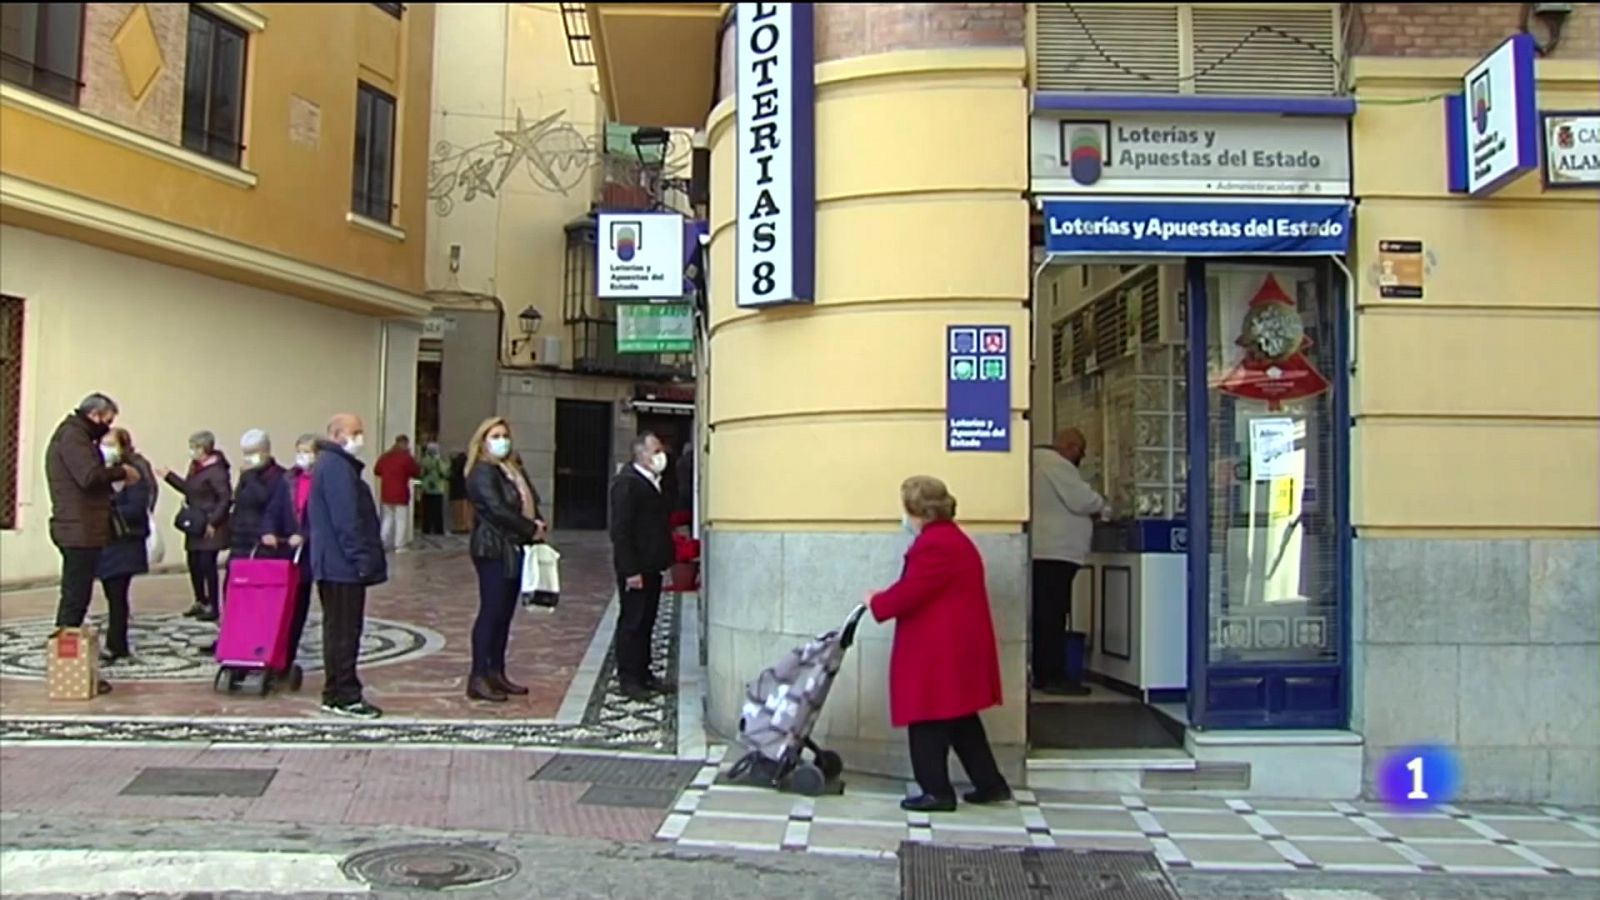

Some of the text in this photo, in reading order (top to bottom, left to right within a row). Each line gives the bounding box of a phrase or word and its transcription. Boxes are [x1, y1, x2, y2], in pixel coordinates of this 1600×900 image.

[1118, 125, 1215, 148] Loterías y
[750, 3, 780, 295] LOTERIAS 8
[1120, 149, 1320, 169] Apuestas del Estado
[1050, 216, 1343, 240] Loterías y Apuestas del Estado
